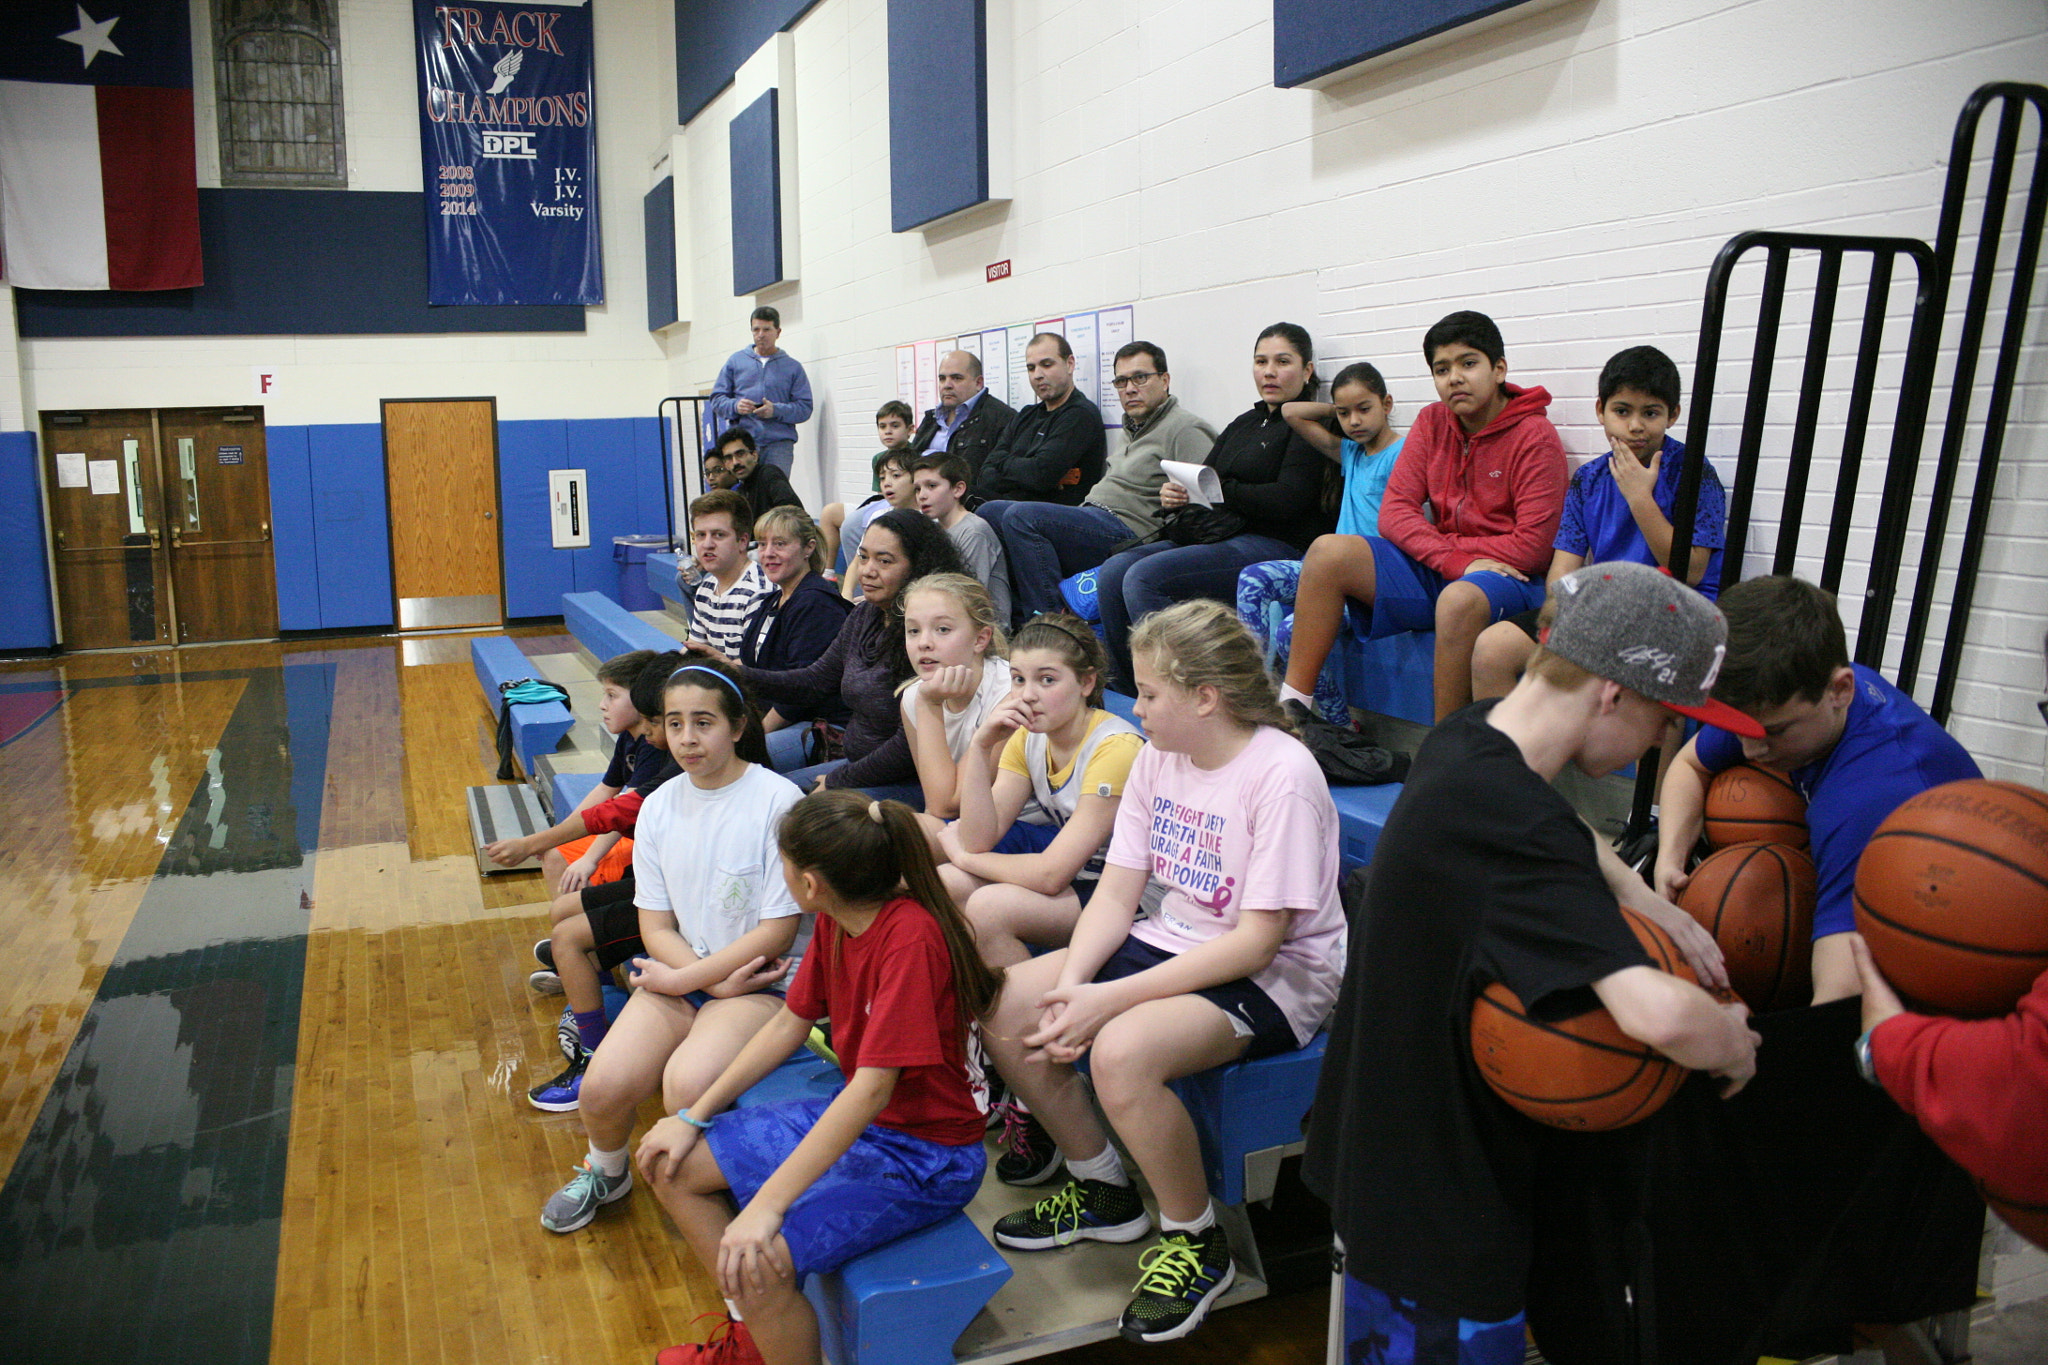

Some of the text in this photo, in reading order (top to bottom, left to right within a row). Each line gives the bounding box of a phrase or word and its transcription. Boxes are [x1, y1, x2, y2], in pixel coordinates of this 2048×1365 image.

[435, 6, 564, 56] TRACK
[426, 86, 588, 128] CHAMPIONS
[482, 135, 537, 154] DPL
[439, 166, 581, 183] 2008 J.V.
[439, 183, 582, 200] 2009 J.V.
[440, 201, 584, 221] 2014 Varsity
[988, 262, 1009, 279] VISITOR
[260, 374, 273, 393] F
[1175, 804, 1204, 827] FIGHT
[1205, 813, 1227, 833] DEFY
[1198, 830, 1223, 853] LIKE
[1179, 846, 1192, 864] A
[1194, 849, 1222, 873] FAITH
